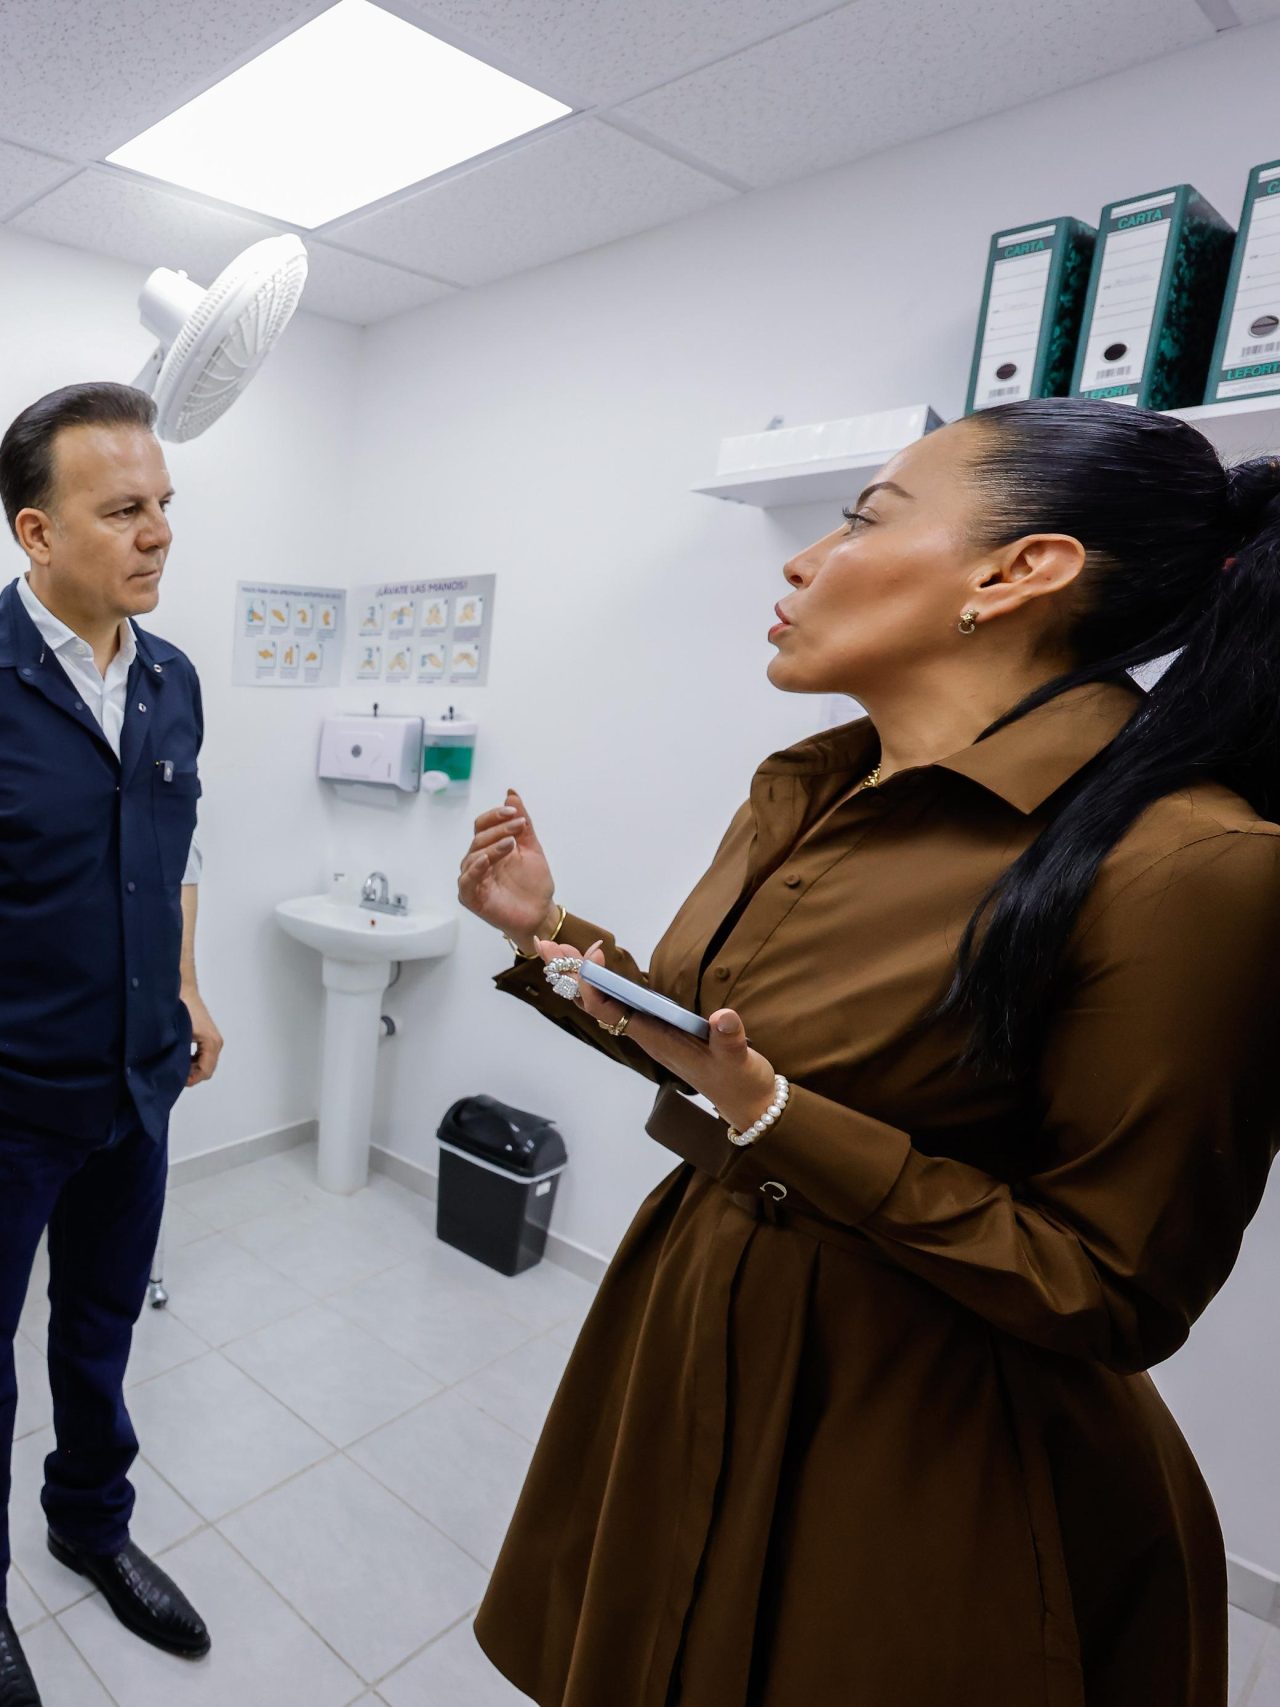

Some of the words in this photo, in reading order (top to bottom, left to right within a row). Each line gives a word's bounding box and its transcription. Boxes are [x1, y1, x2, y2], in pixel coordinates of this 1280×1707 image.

[1118, 208, 1162, 229] CARTA
[1005, 239, 1045, 258] CARTA
[1227, 362, 1279, 380] LEFORT
[410, 583, 426, 594] LAS
